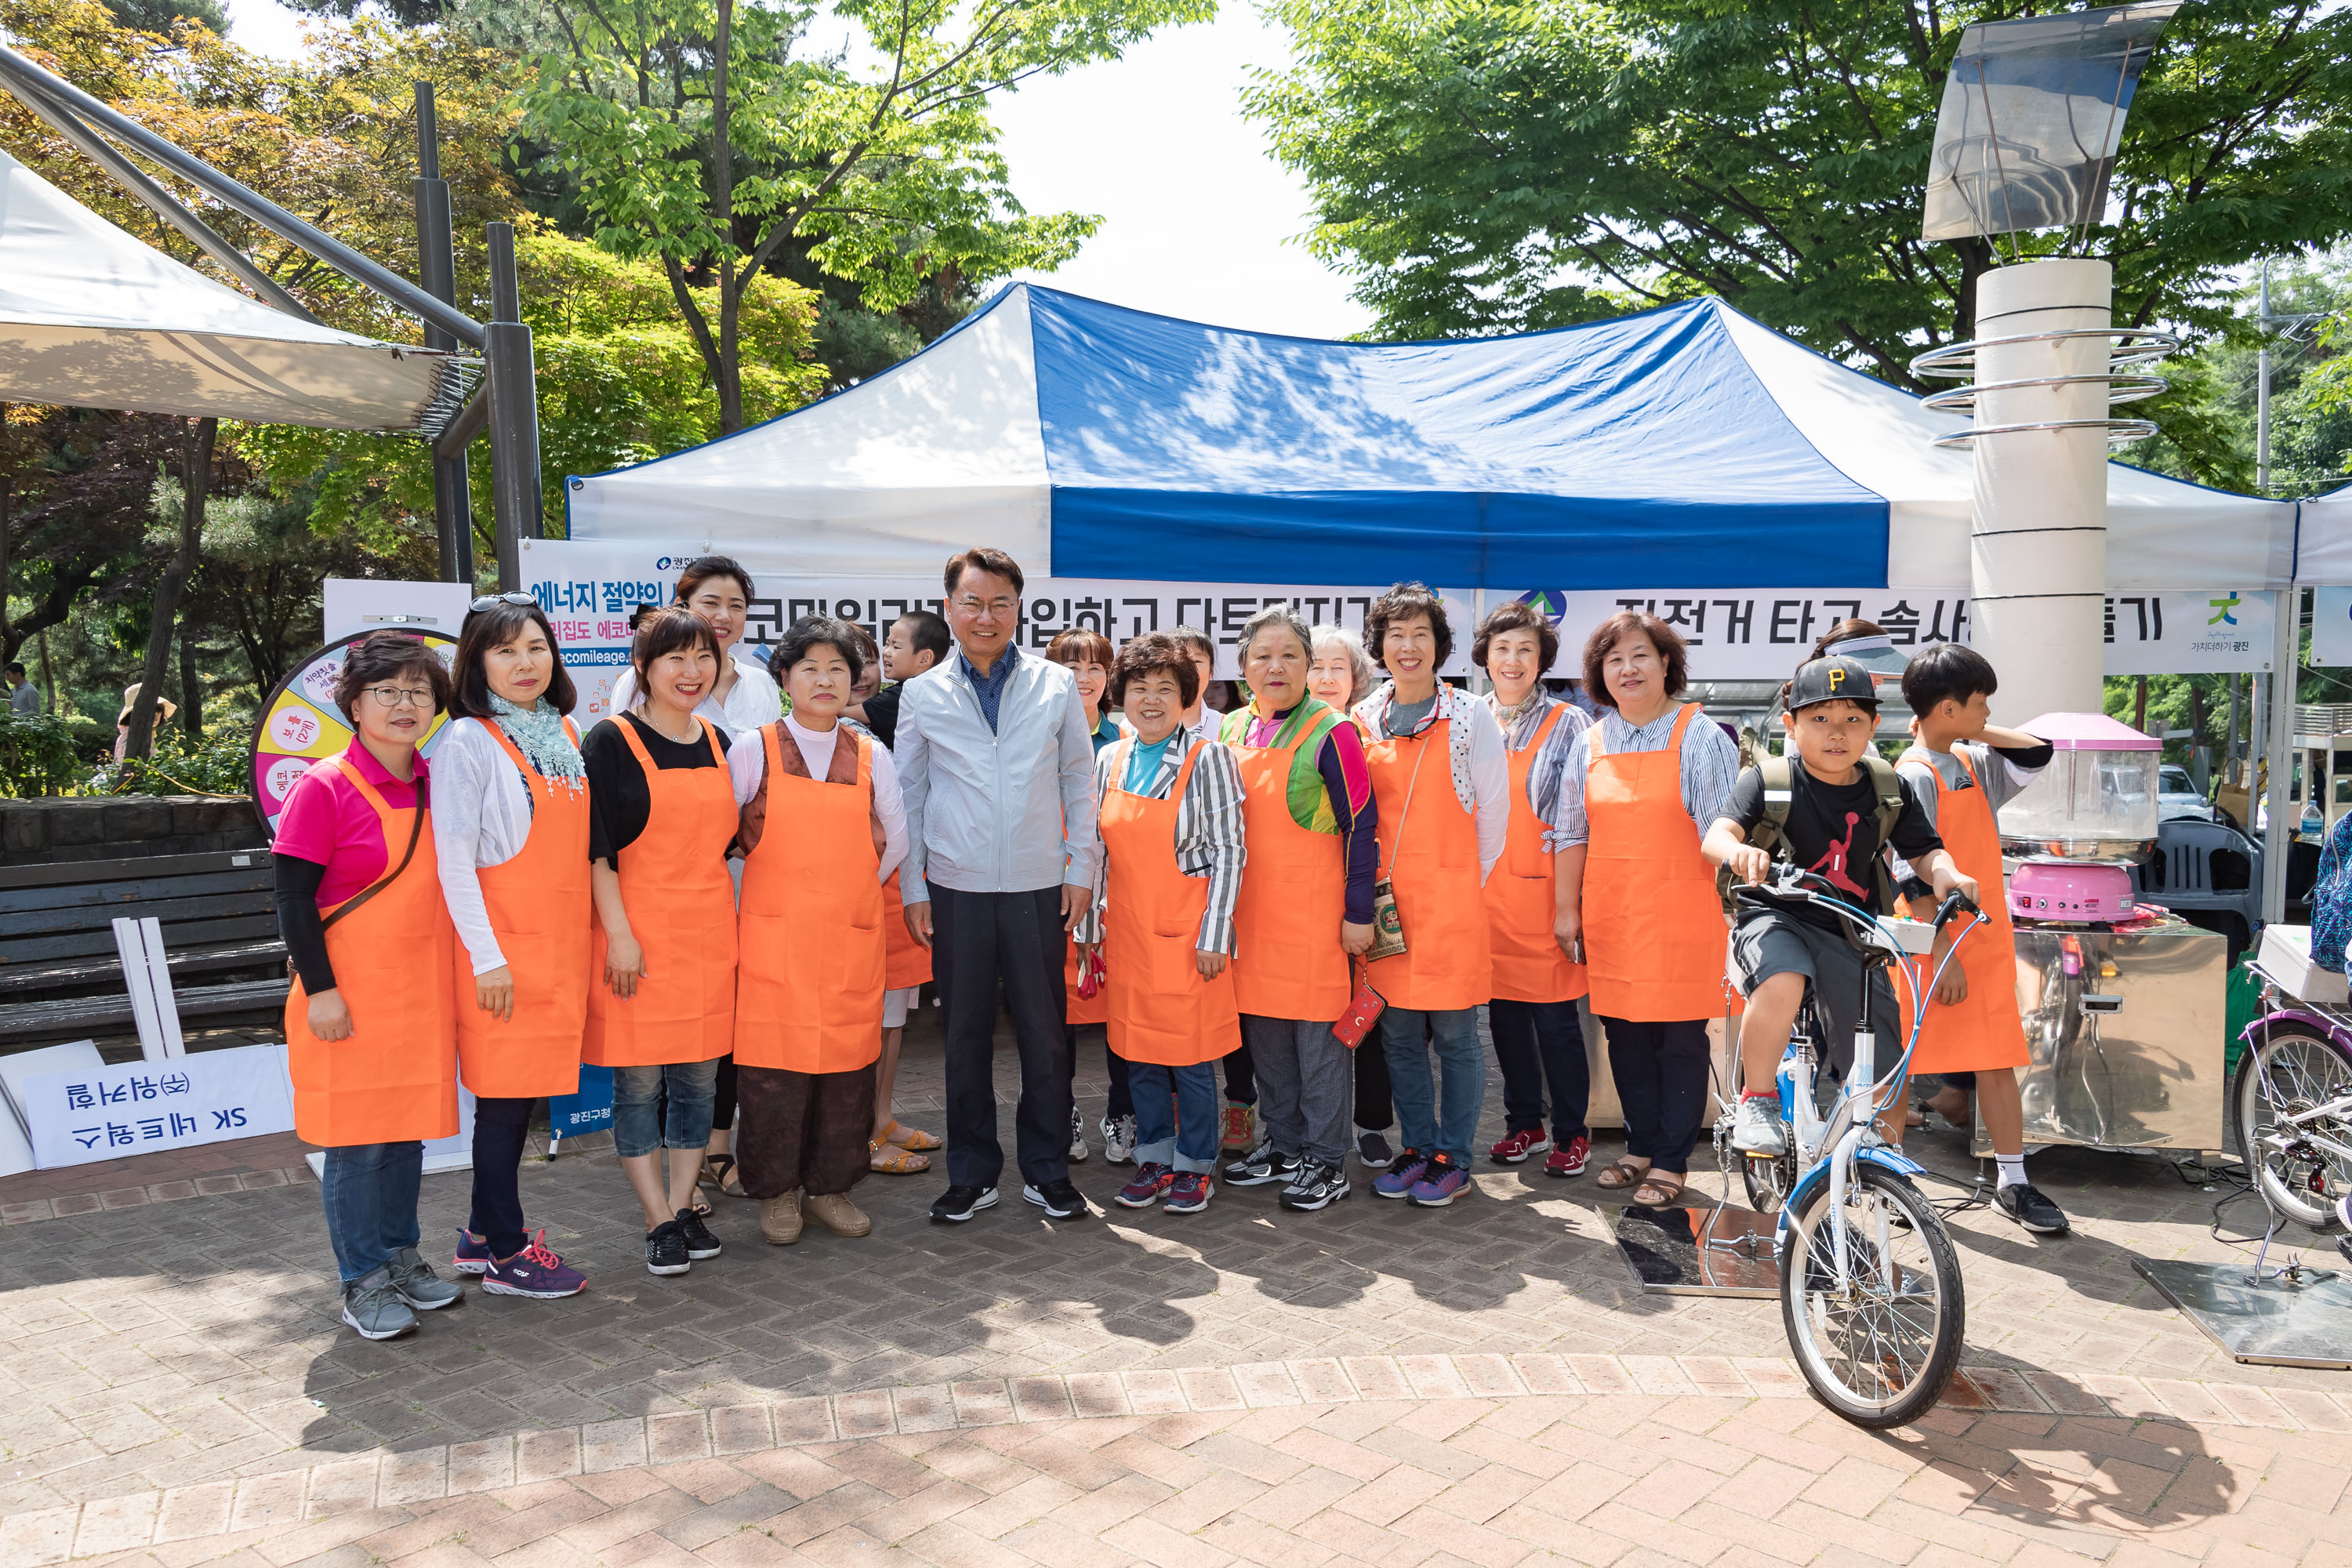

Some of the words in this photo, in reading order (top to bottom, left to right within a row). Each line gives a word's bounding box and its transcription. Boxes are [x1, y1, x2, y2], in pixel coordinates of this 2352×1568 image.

[531, 581, 597, 613] 에너지
[601, 581, 663, 613] 절약의
[550, 620, 591, 641] 리집도
[1769, 600, 1862, 644] 타고
[1878, 600, 1972, 645] 솜사
[560, 649, 632, 666] ecomileage.
[2191, 641, 2231, 652] 가치더하기
[2233, 641, 2249, 652] 광진
[1828, 669, 1846, 691] P
[296, 720, 316, 743] (2개)
[276, 770, 289, 791] 에코
[66, 1072, 191, 1111] (주)워커힐
[210, 1107, 248, 1131] SK
[570, 1107, 611, 1124] 광진구청
[71, 1112, 198, 1149] 네트웍스
